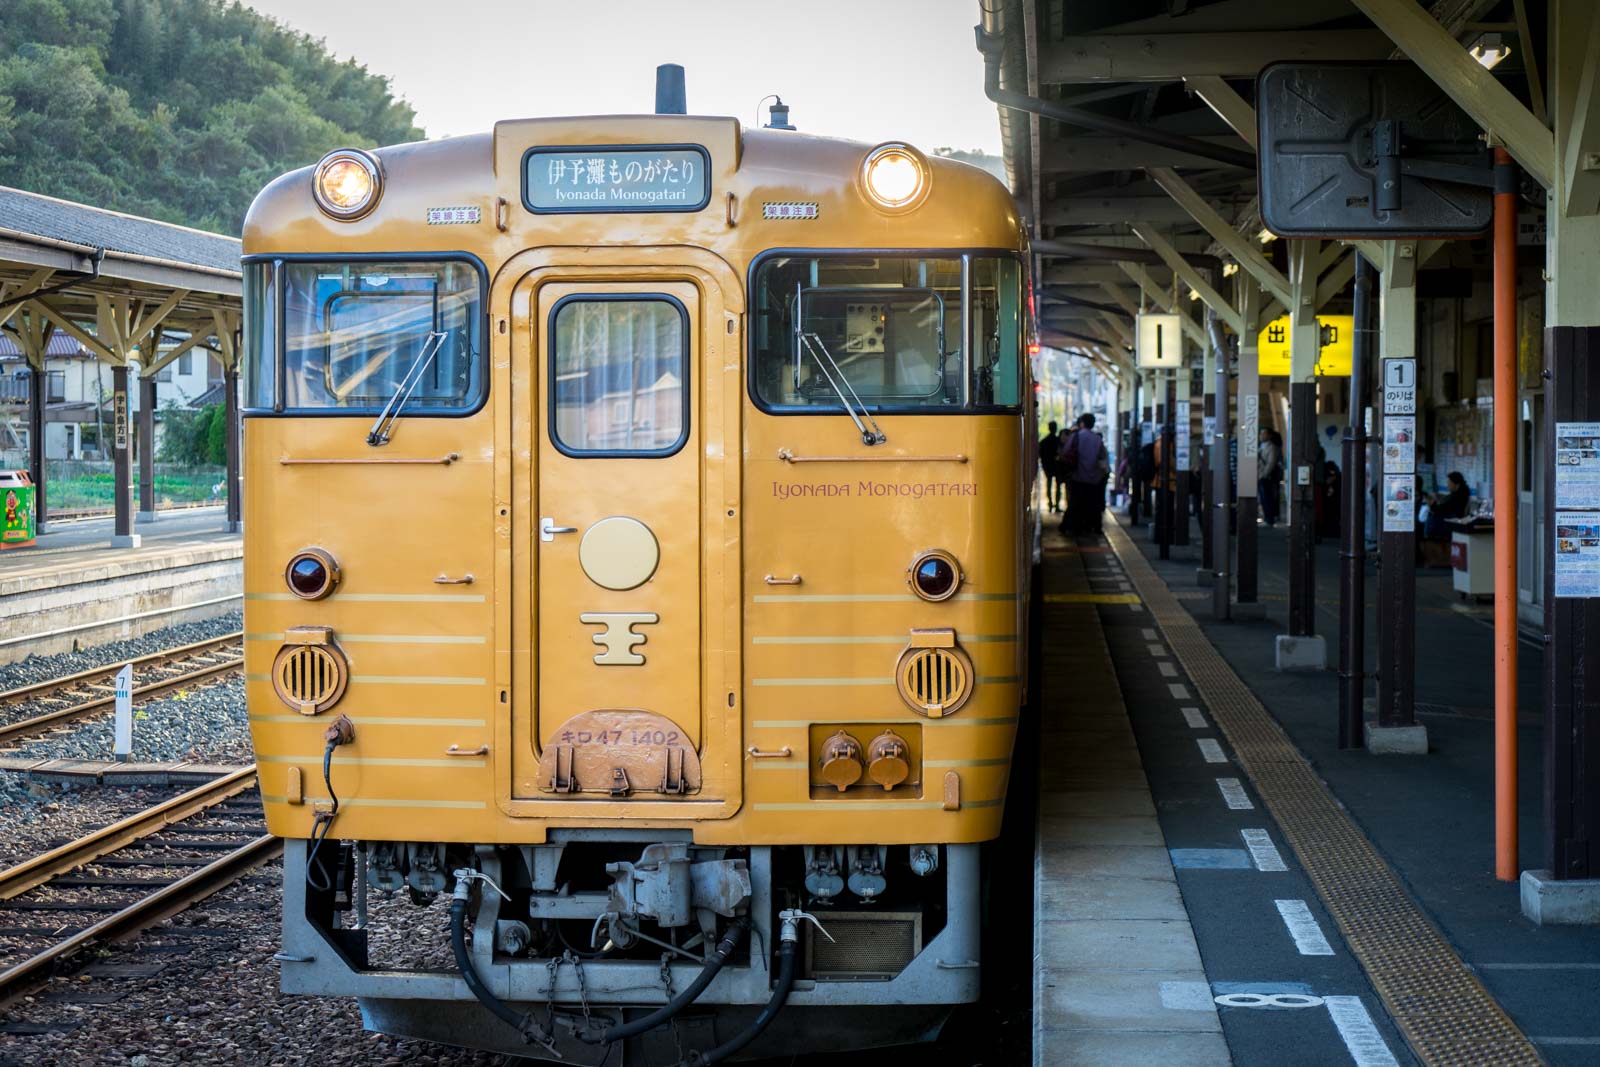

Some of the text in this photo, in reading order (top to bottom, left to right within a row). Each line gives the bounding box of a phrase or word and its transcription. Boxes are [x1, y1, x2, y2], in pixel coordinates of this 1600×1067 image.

[548, 158, 694, 185] 伊予灘ものがたり
[555, 188, 686, 202] Iyonada Monogatari
[1393, 364, 1404, 384] 1
[1386, 391, 1414, 401] のりば
[1386, 403, 1414, 412] Track
[118, 676, 126, 689] 7
[631, 731, 680, 746] 1402
